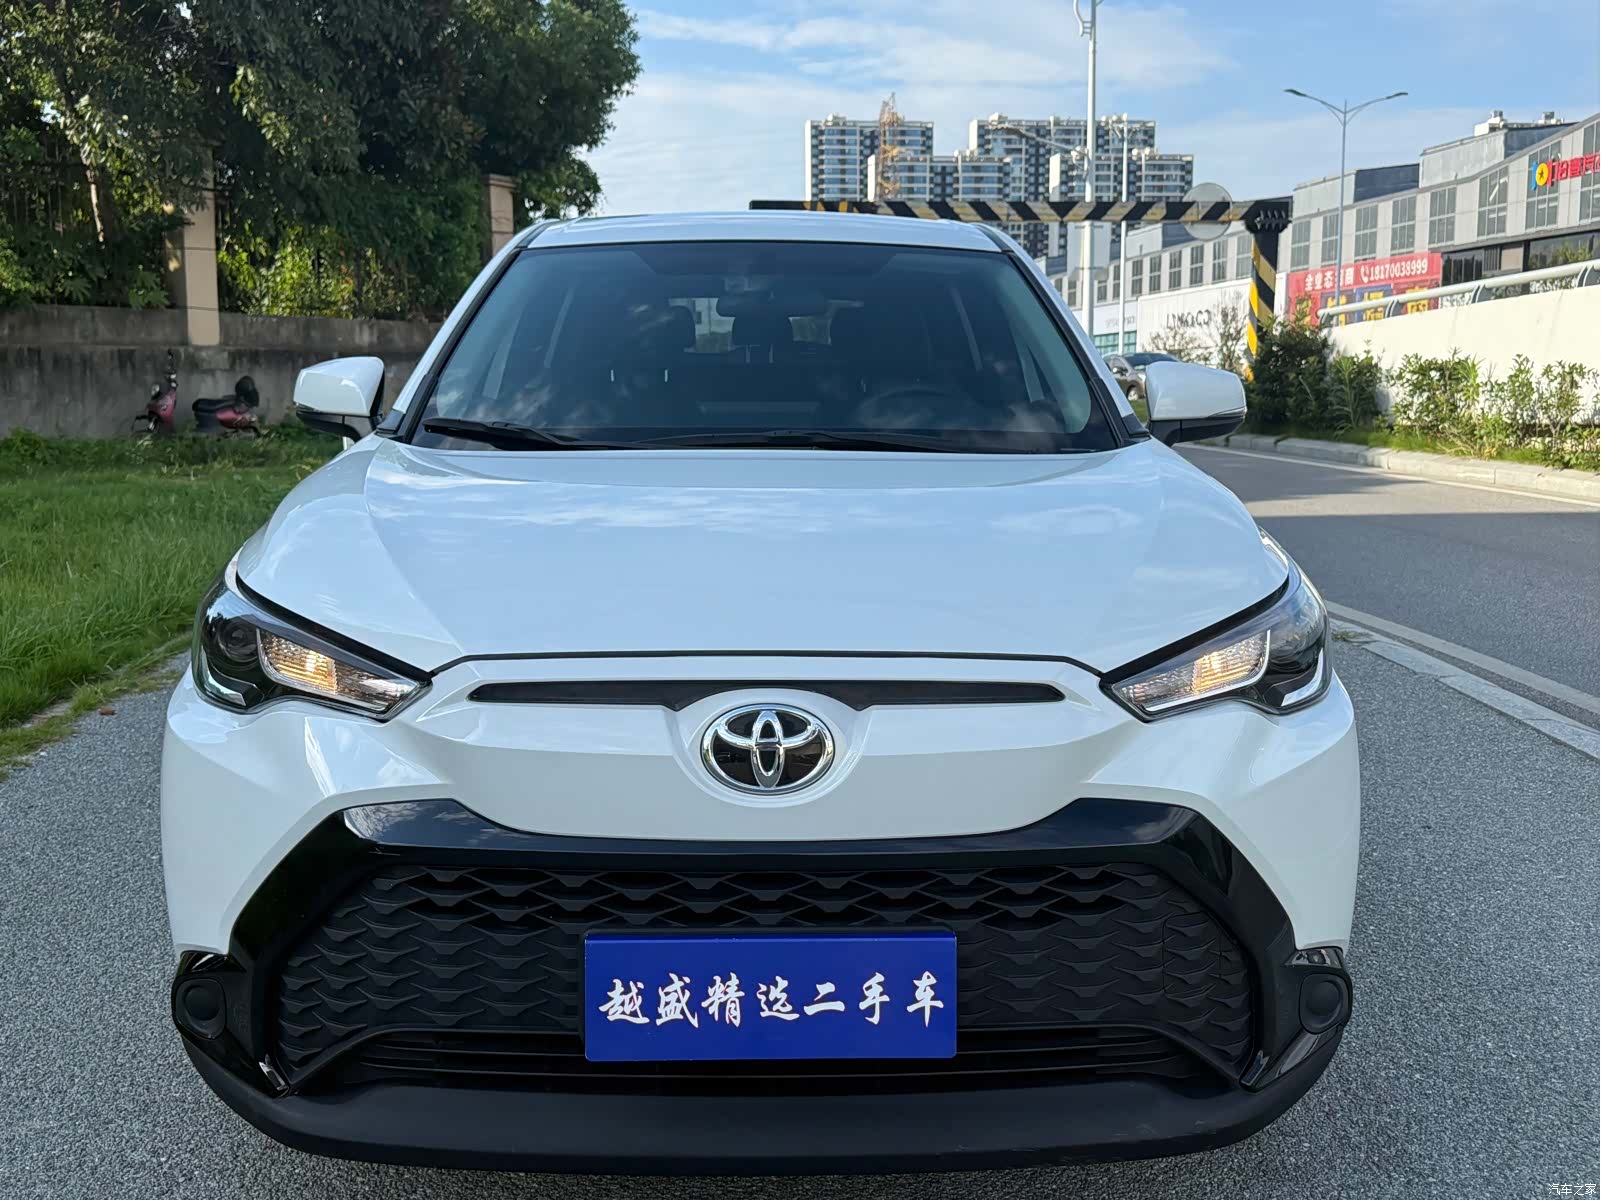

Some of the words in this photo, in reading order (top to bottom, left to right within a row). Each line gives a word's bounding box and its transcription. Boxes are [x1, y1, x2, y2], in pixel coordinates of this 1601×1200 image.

[1370, 257, 1428, 282] 18170038999
[598, 971, 945, 1028] 越盛精选二手车
